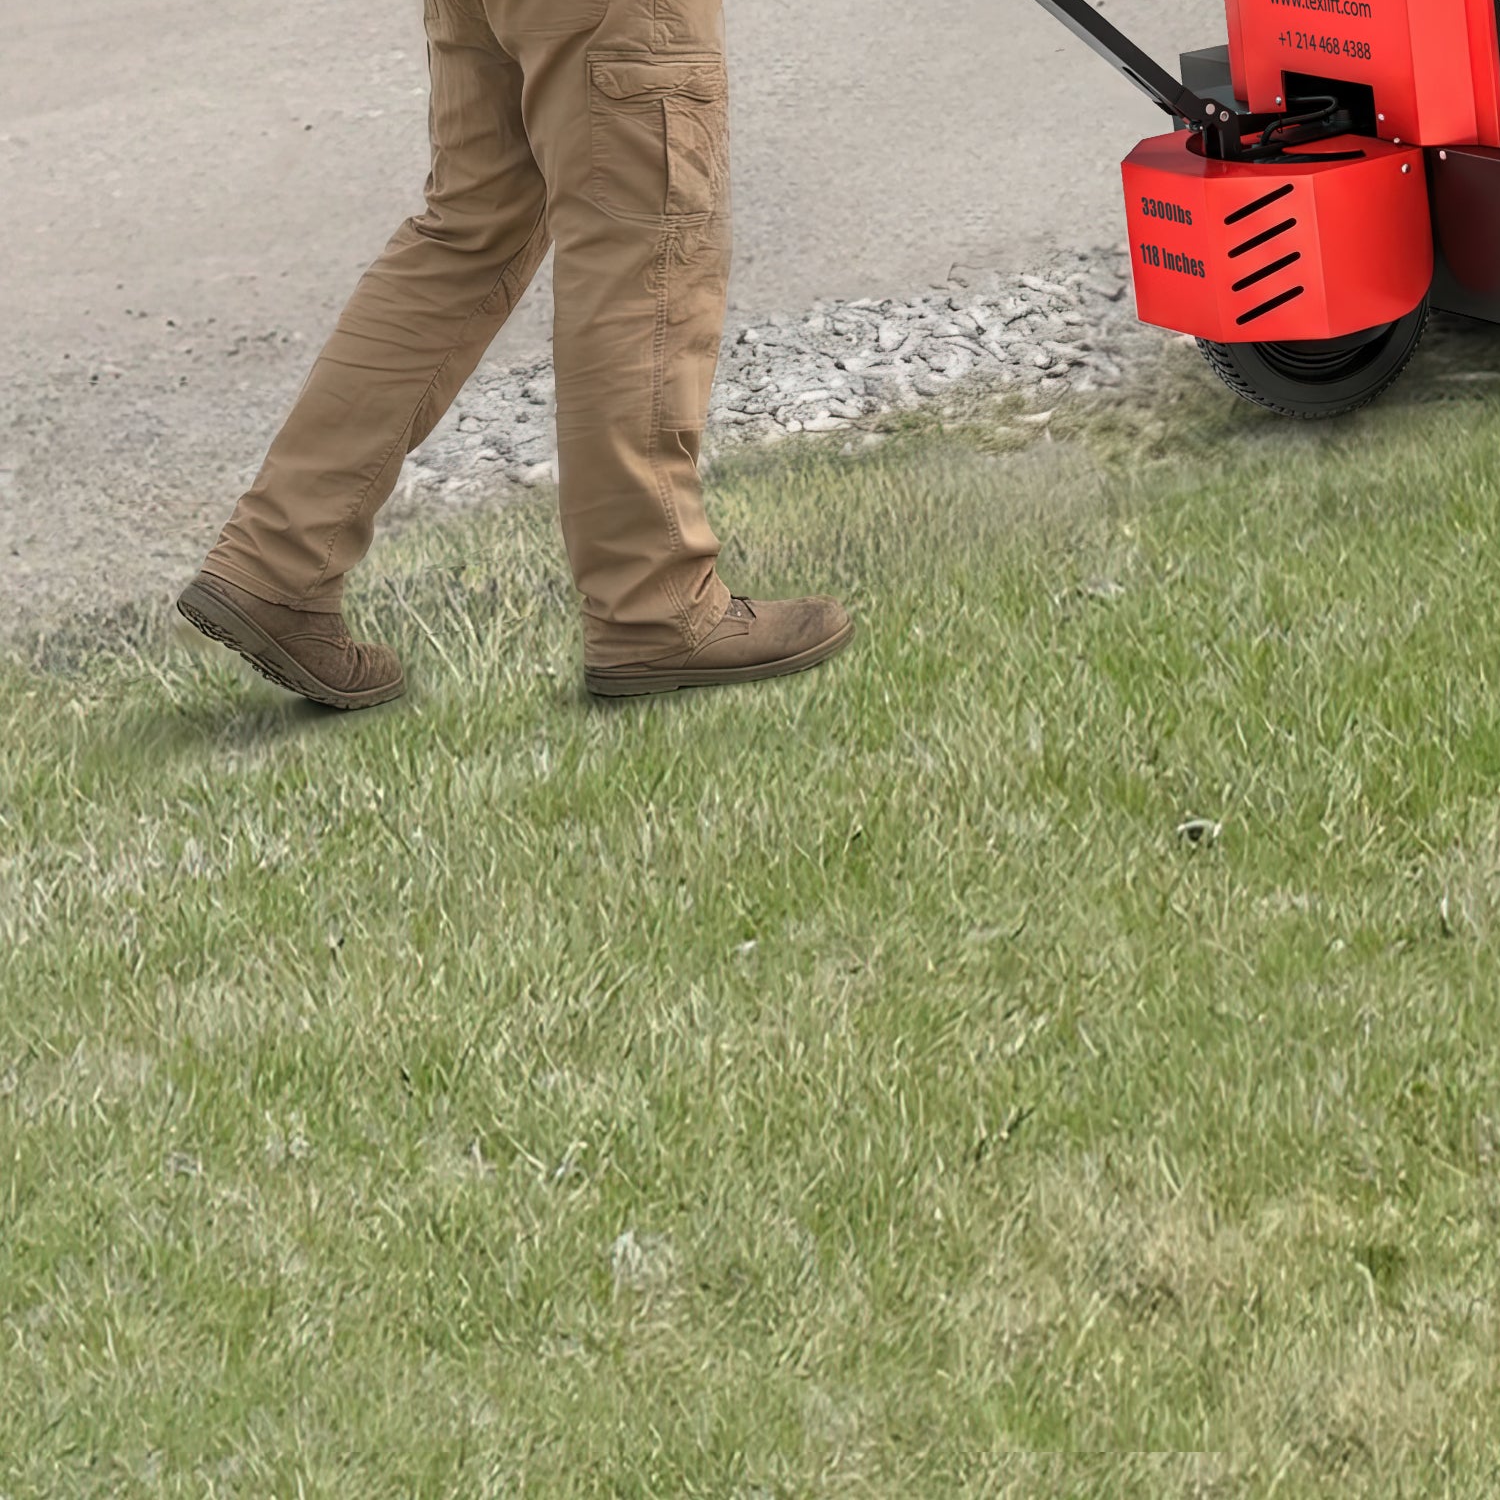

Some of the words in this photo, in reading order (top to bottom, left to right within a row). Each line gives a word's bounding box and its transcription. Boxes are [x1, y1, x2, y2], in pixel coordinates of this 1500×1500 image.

[1278, 30, 1292, 48] +1
[1295, 31, 1317, 52] 214
[1318, 36, 1341, 55] 468
[1342, 40, 1372, 61] 4388
[1141, 196, 1193, 226] 3300lbs
[1140, 243, 1160, 267] 118
[1162, 247, 1206, 278] Inches
